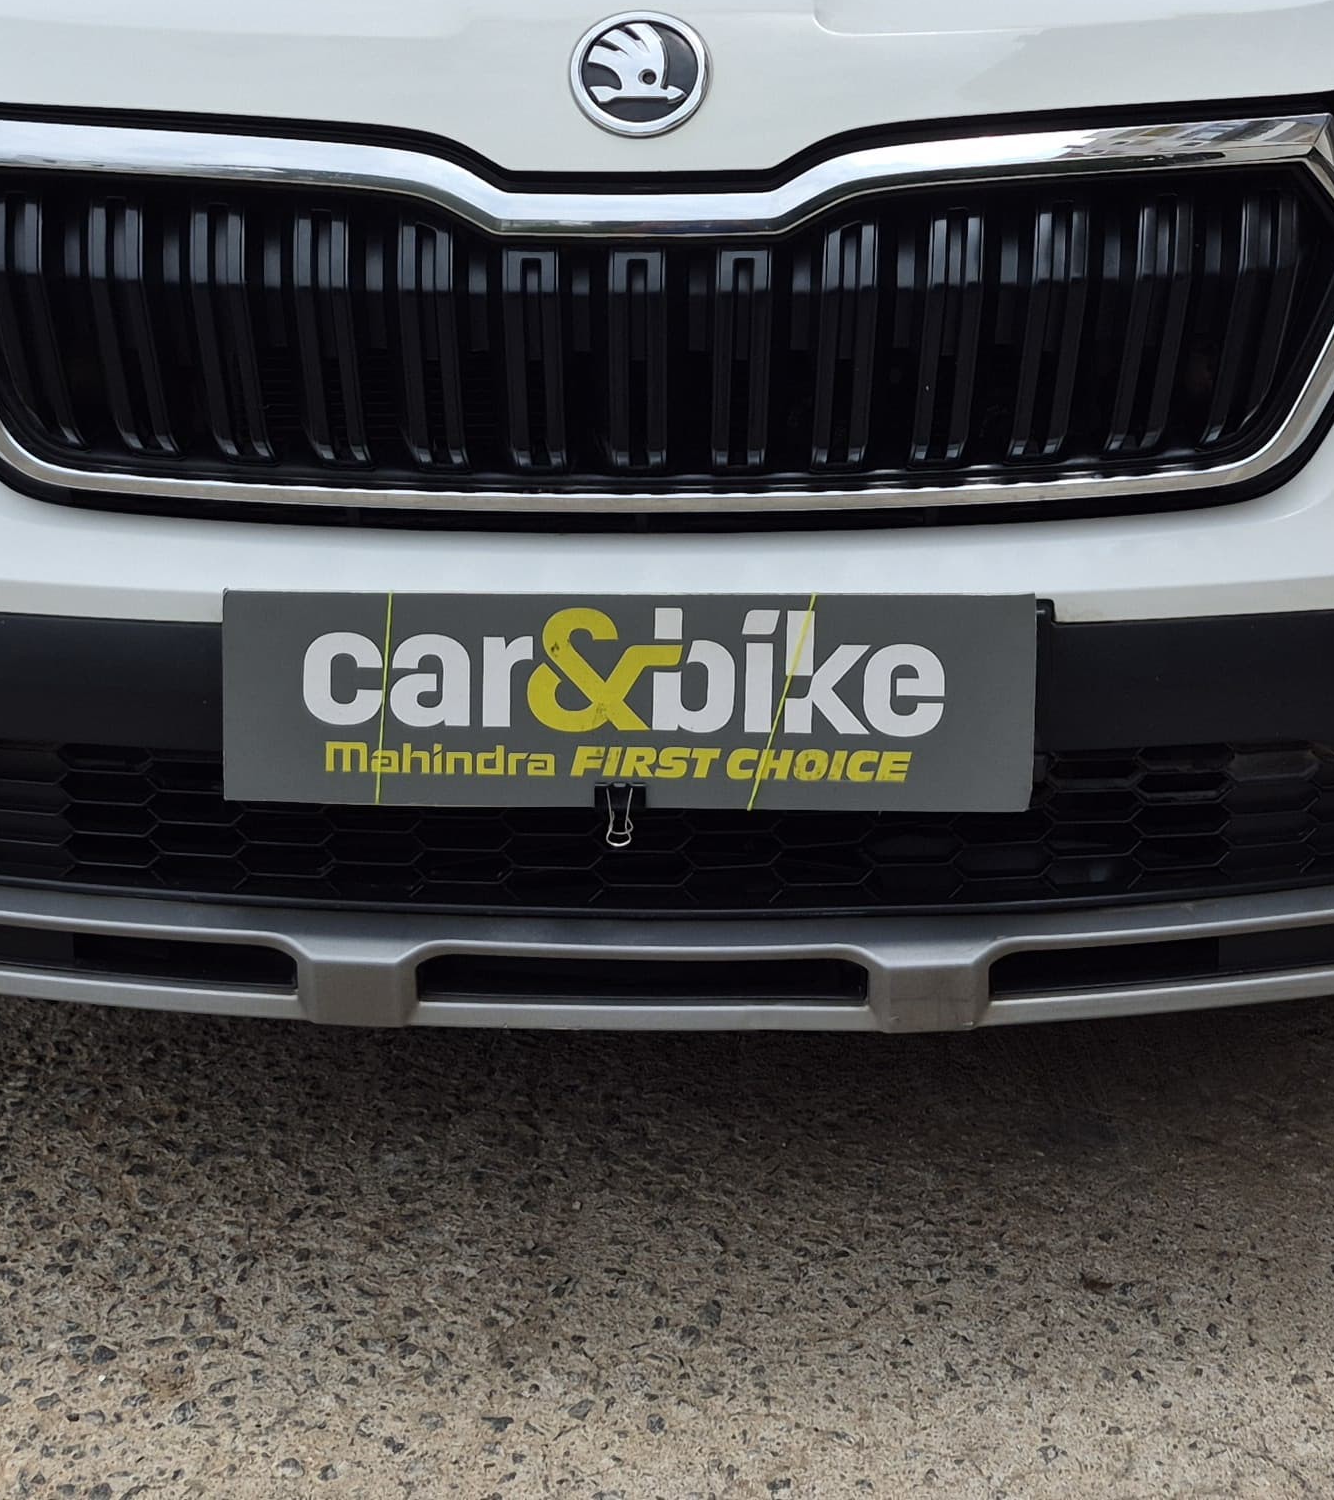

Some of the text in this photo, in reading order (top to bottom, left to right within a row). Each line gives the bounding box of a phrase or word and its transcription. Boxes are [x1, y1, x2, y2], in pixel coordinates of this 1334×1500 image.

[303, 607, 945, 737] car&bike
[325, 741, 913, 783] Mahindra FIRST CHOICE
